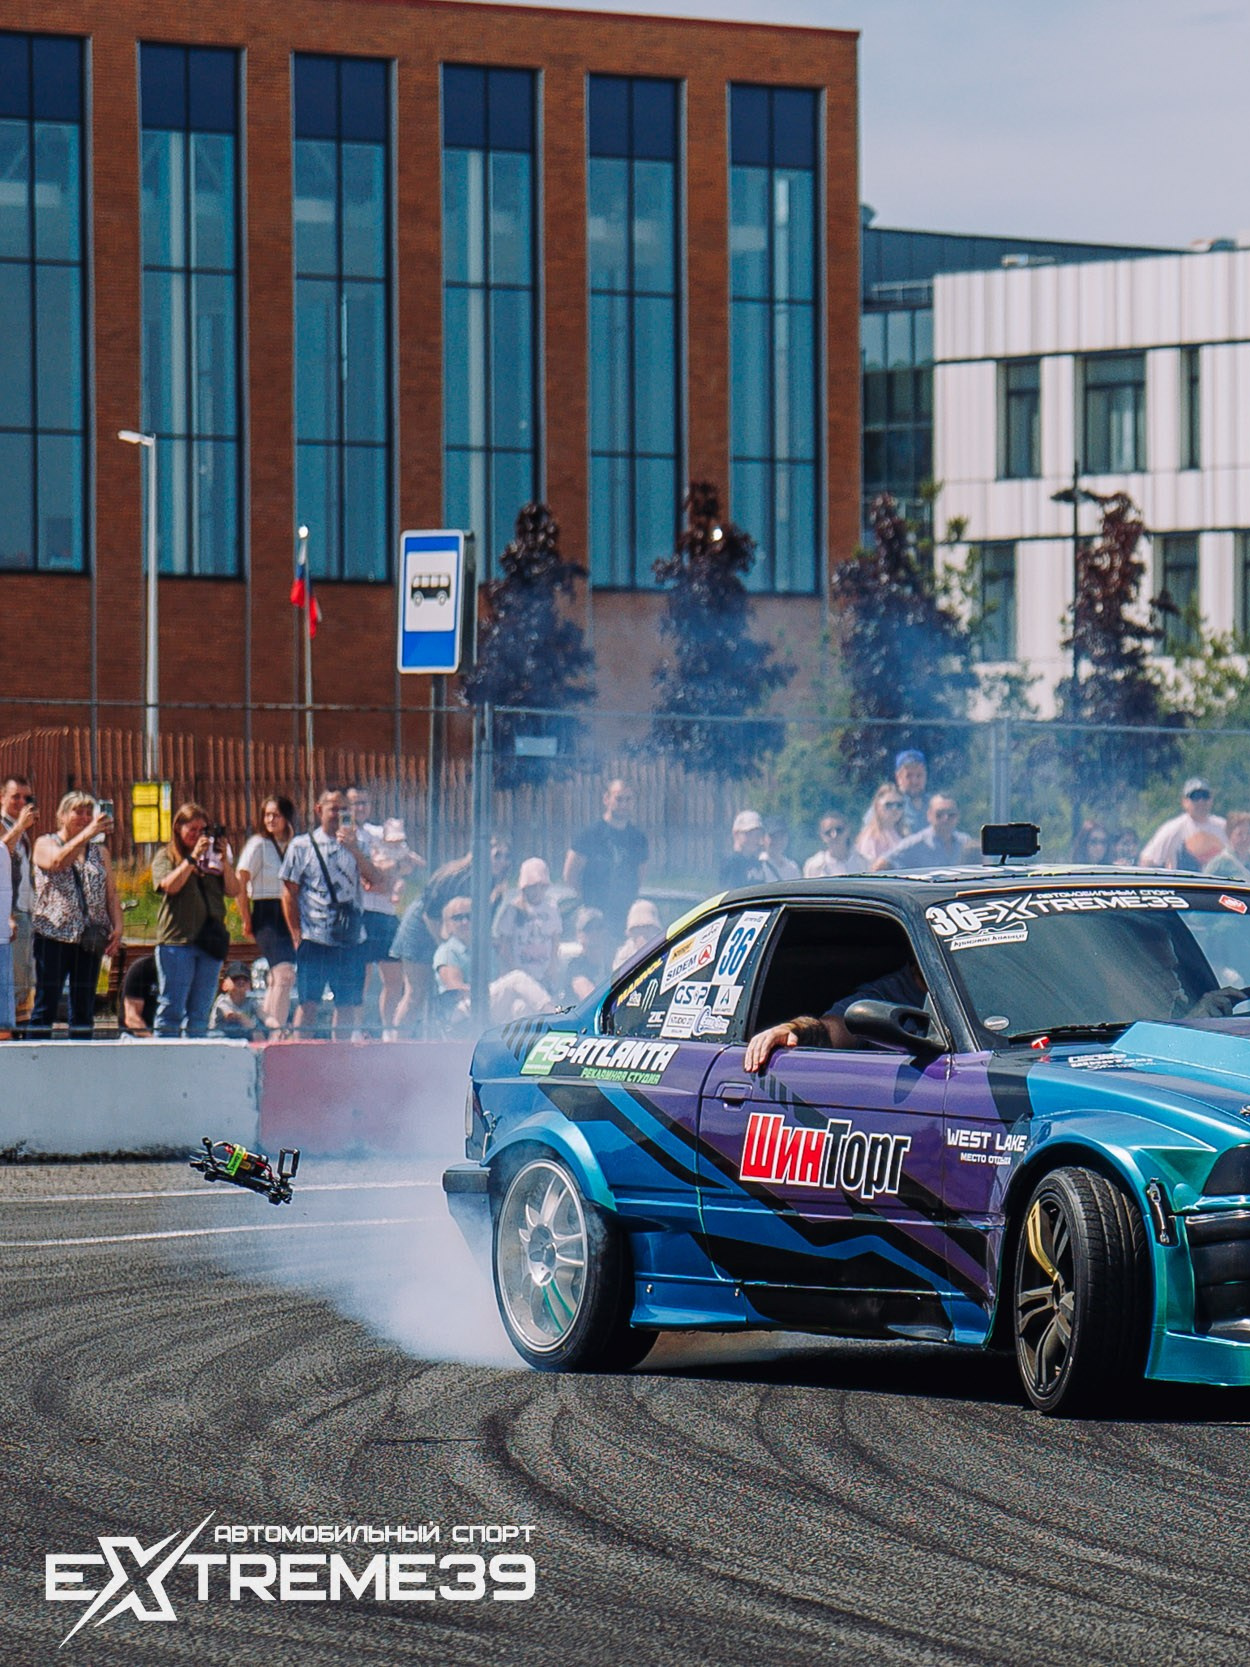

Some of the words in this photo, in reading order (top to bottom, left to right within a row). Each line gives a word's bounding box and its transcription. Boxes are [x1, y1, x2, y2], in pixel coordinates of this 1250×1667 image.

[1036, 889, 1137, 899] АВТОМОБИЛЬНЫЙ
[1139, 889, 1176, 897] СПОРТ
[926, 902, 983, 936] 36
[718, 927, 756, 976] 36
[666, 953, 697, 981] SIDEM
[648, 1011, 666, 1023] ZIC
[529, 1036, 680, 1072] AS-ATLANTA
[627, 1071, 662, 1085] СТУДИЯ
[946, 1128, 992, 1150] WEST
[995, 1132, 1027, 1152] LAKE
[739, 1113, 912, 1199] ШинТорг
[960, 1152, 987, 1164] МЕСТО
